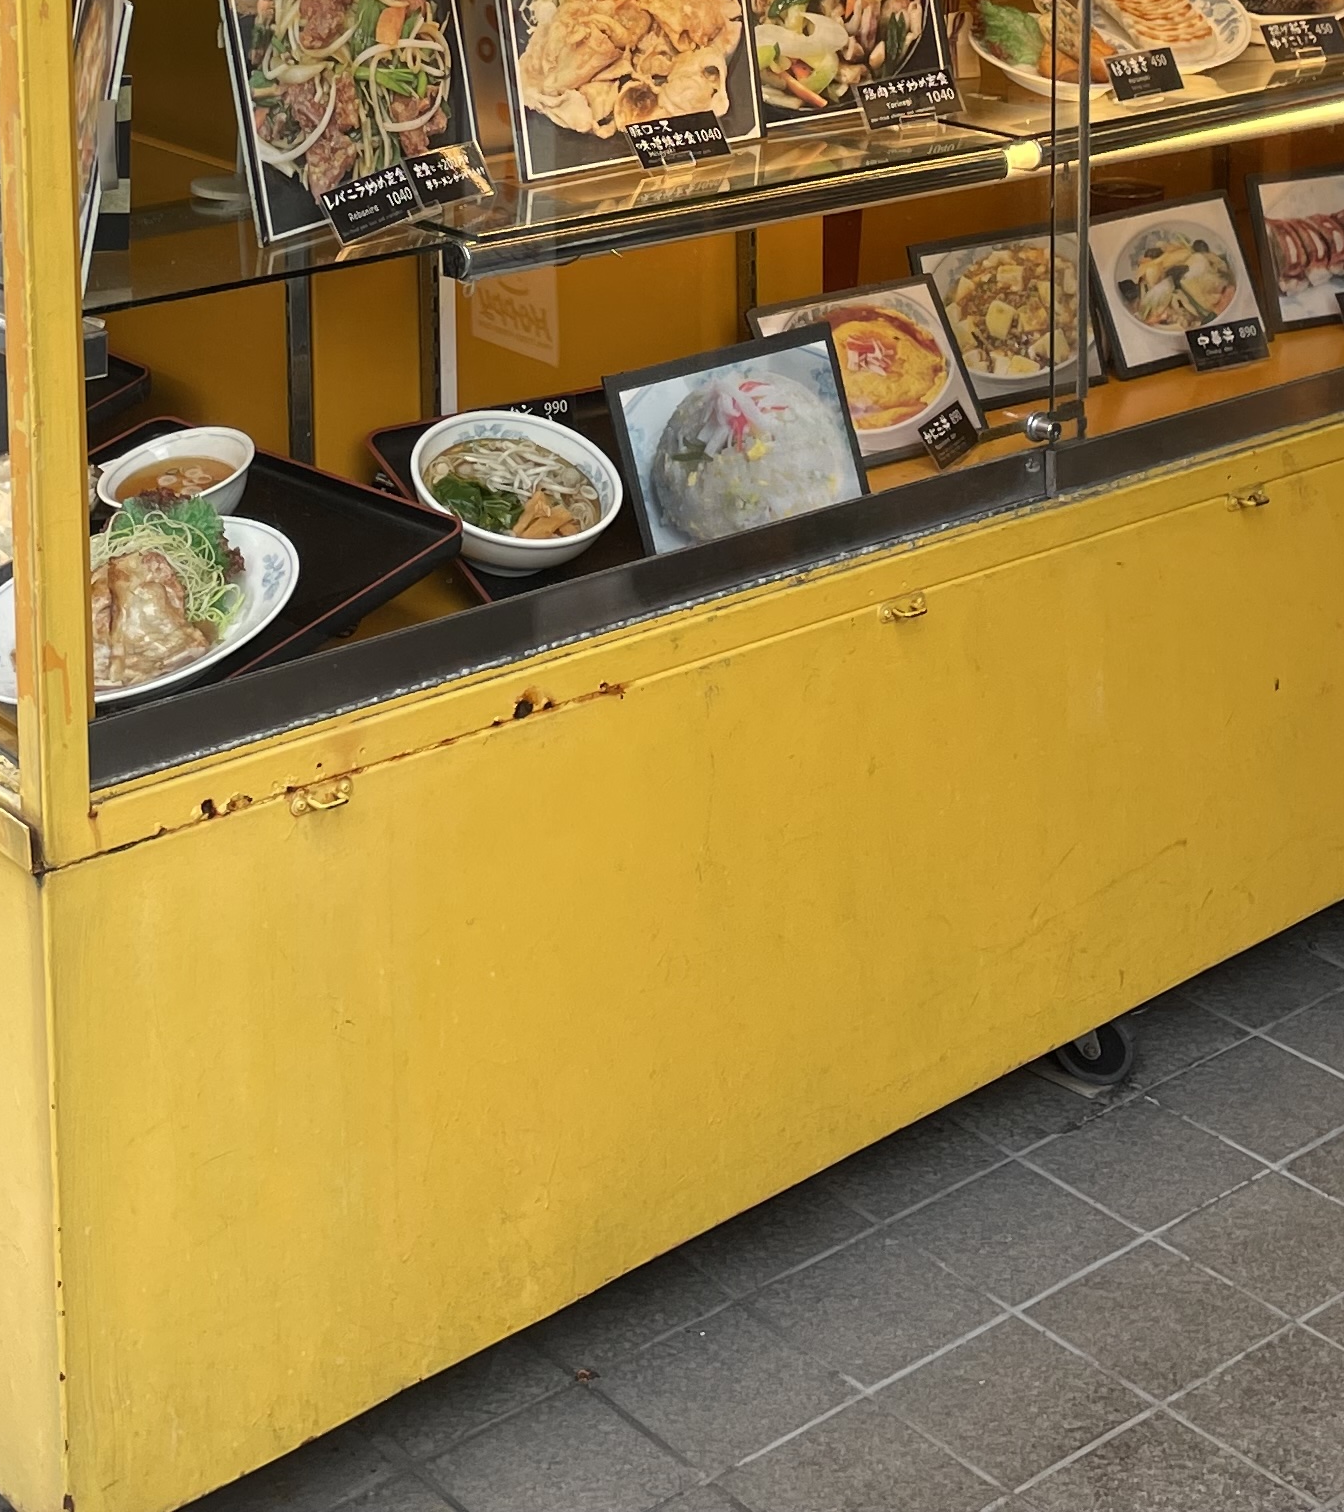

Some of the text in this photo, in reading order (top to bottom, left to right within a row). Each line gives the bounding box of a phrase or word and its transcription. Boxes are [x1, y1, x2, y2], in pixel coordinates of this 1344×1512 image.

[1315, 23, 1333, 35] 450
[1150, 54, 1168, 67] 450
[925, 88, 955, 105] 1040
[695, 127, 722, 143] 1040
[323, 166, 407, 211] レバニラ炒め定食
[386, 186, 413, 207] 1040
[1238, 325, 1257, 338] 890
[544, 399, 568, 416] 990
